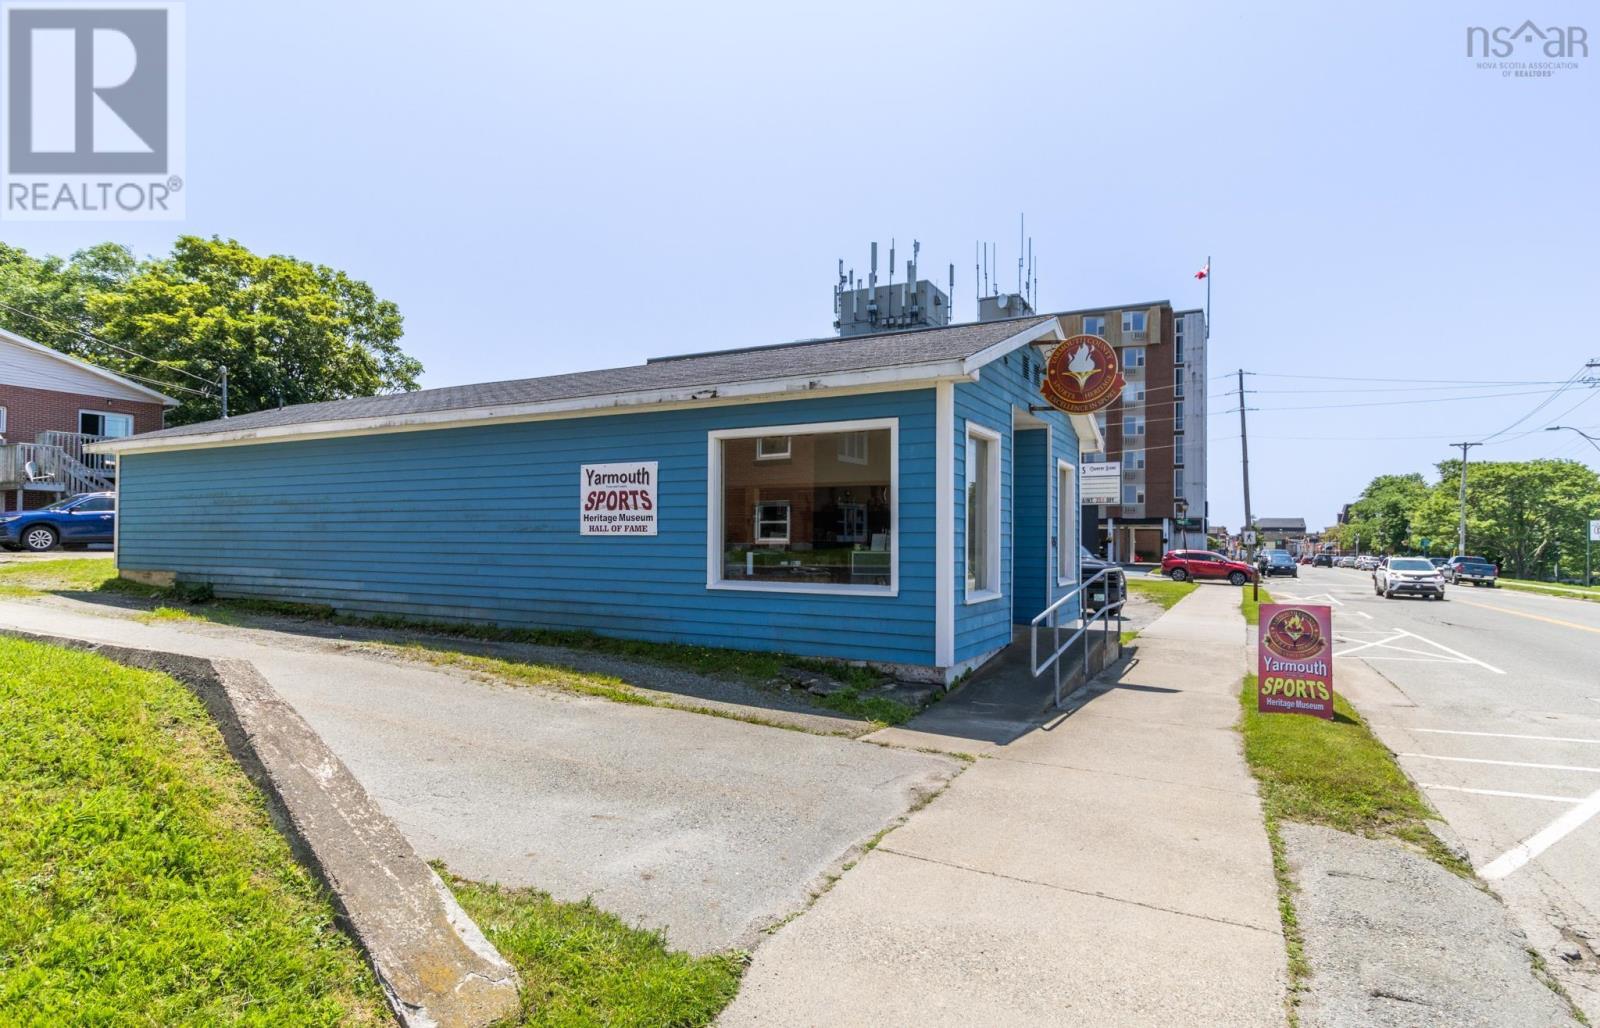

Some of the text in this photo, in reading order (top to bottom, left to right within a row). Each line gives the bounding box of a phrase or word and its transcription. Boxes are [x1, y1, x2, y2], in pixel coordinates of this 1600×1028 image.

[1086, 338, 1114, 361] COUNTY
[1084, 375, 1113, 399] HERITAGE
[585, 467, 650, 487] Yarmouth
[584, 489, 653, 511] SPORTS
[583, 513, 654, 524] Heritage Museum
[588, 525, 648, 533] HALL OF FAME
[1263, 656, 1328, 677] Yarmouth
[1261, 677, 1331, 701] SPORTS
[1266, 697, 1325, 711] Heritage Museum
